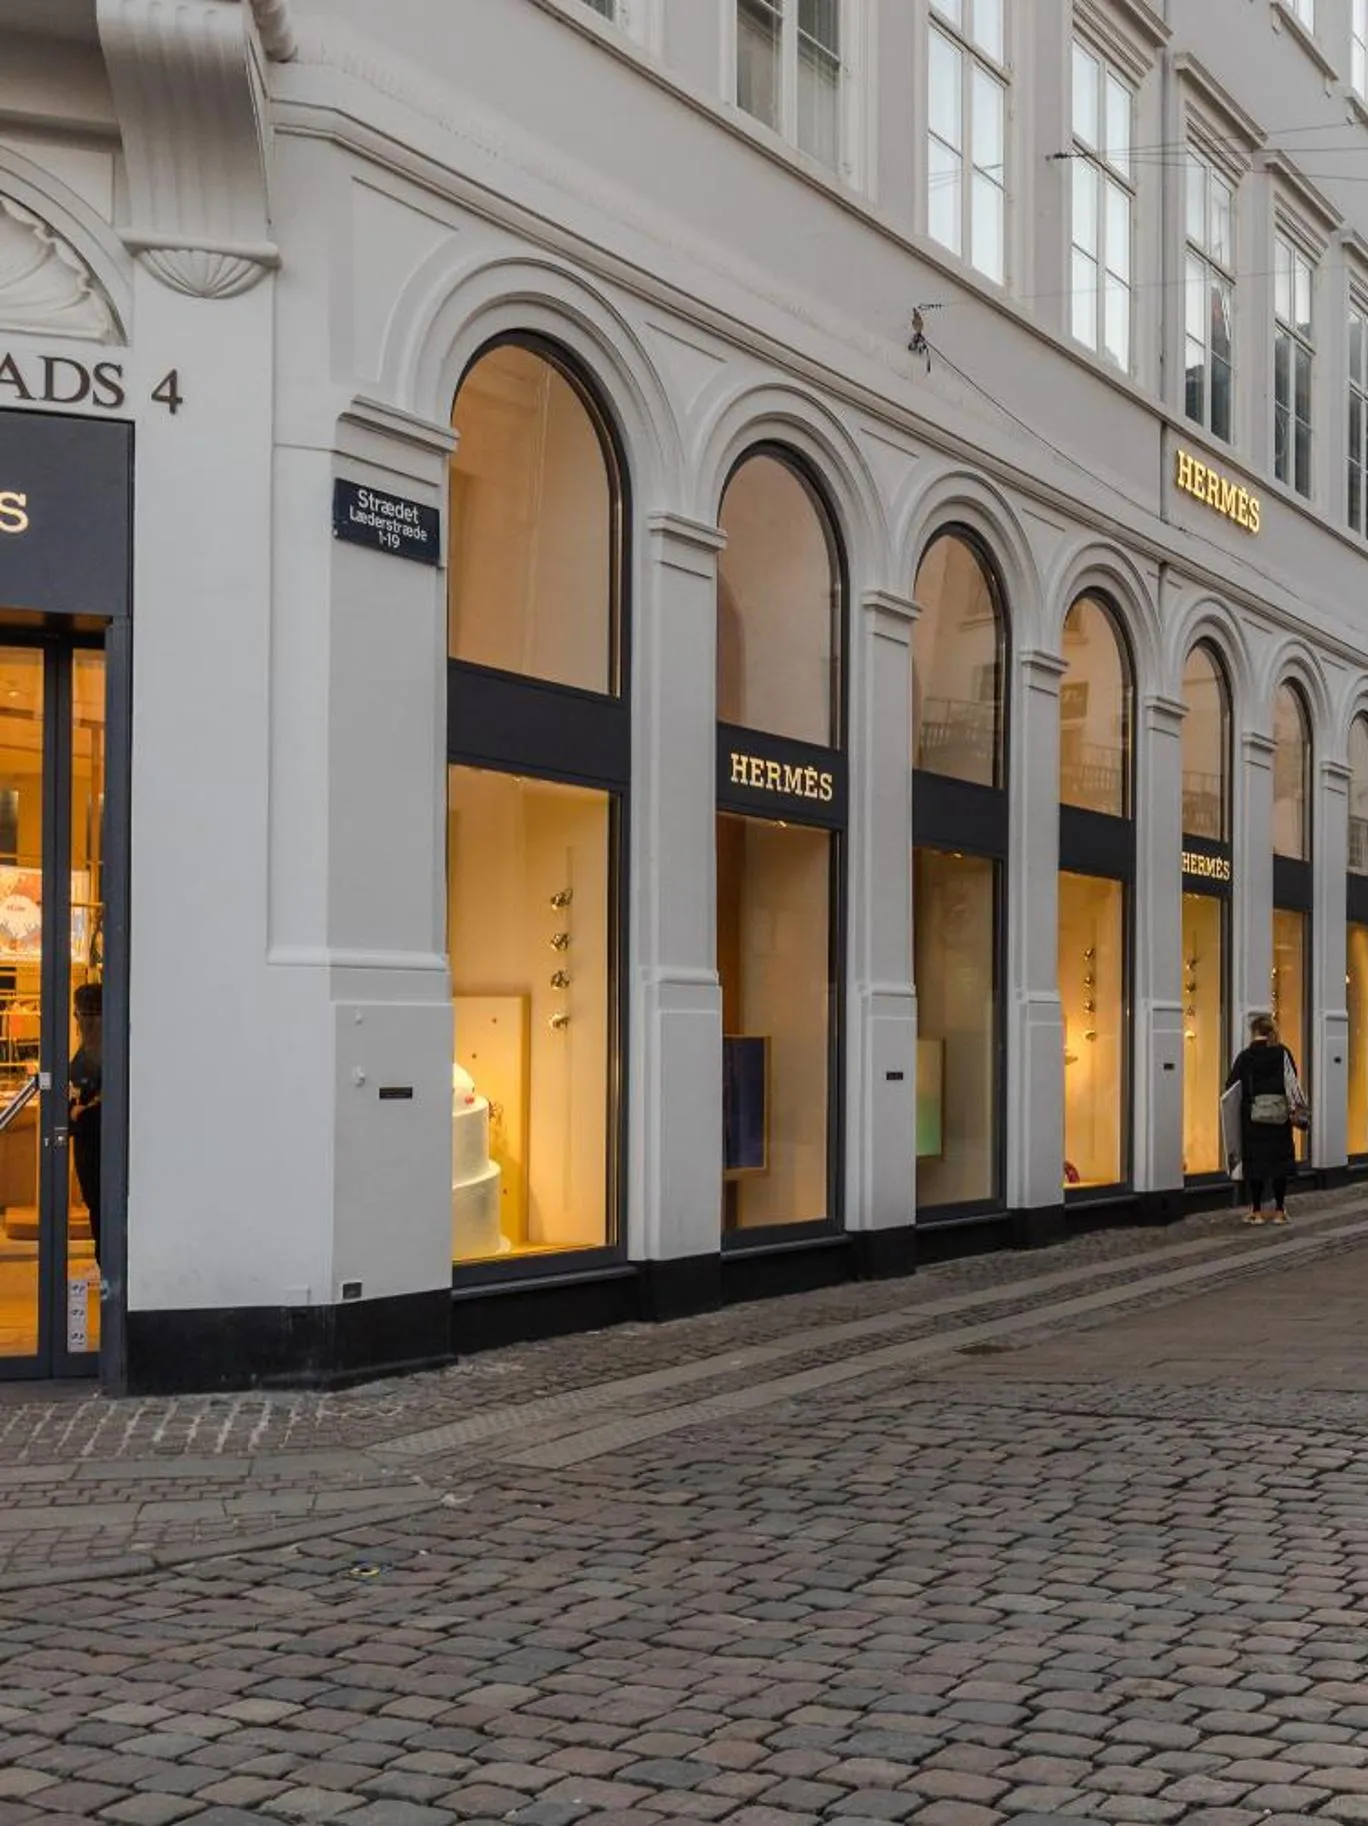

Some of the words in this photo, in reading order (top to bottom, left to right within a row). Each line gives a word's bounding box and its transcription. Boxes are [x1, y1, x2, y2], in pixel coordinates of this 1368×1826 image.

[151, 369, 183, 414] 4
[349, 504, 428, 543] Læderstræde
[358, 489, 419, 525] Strædet
[379, 530, 401, 549] 1-19
